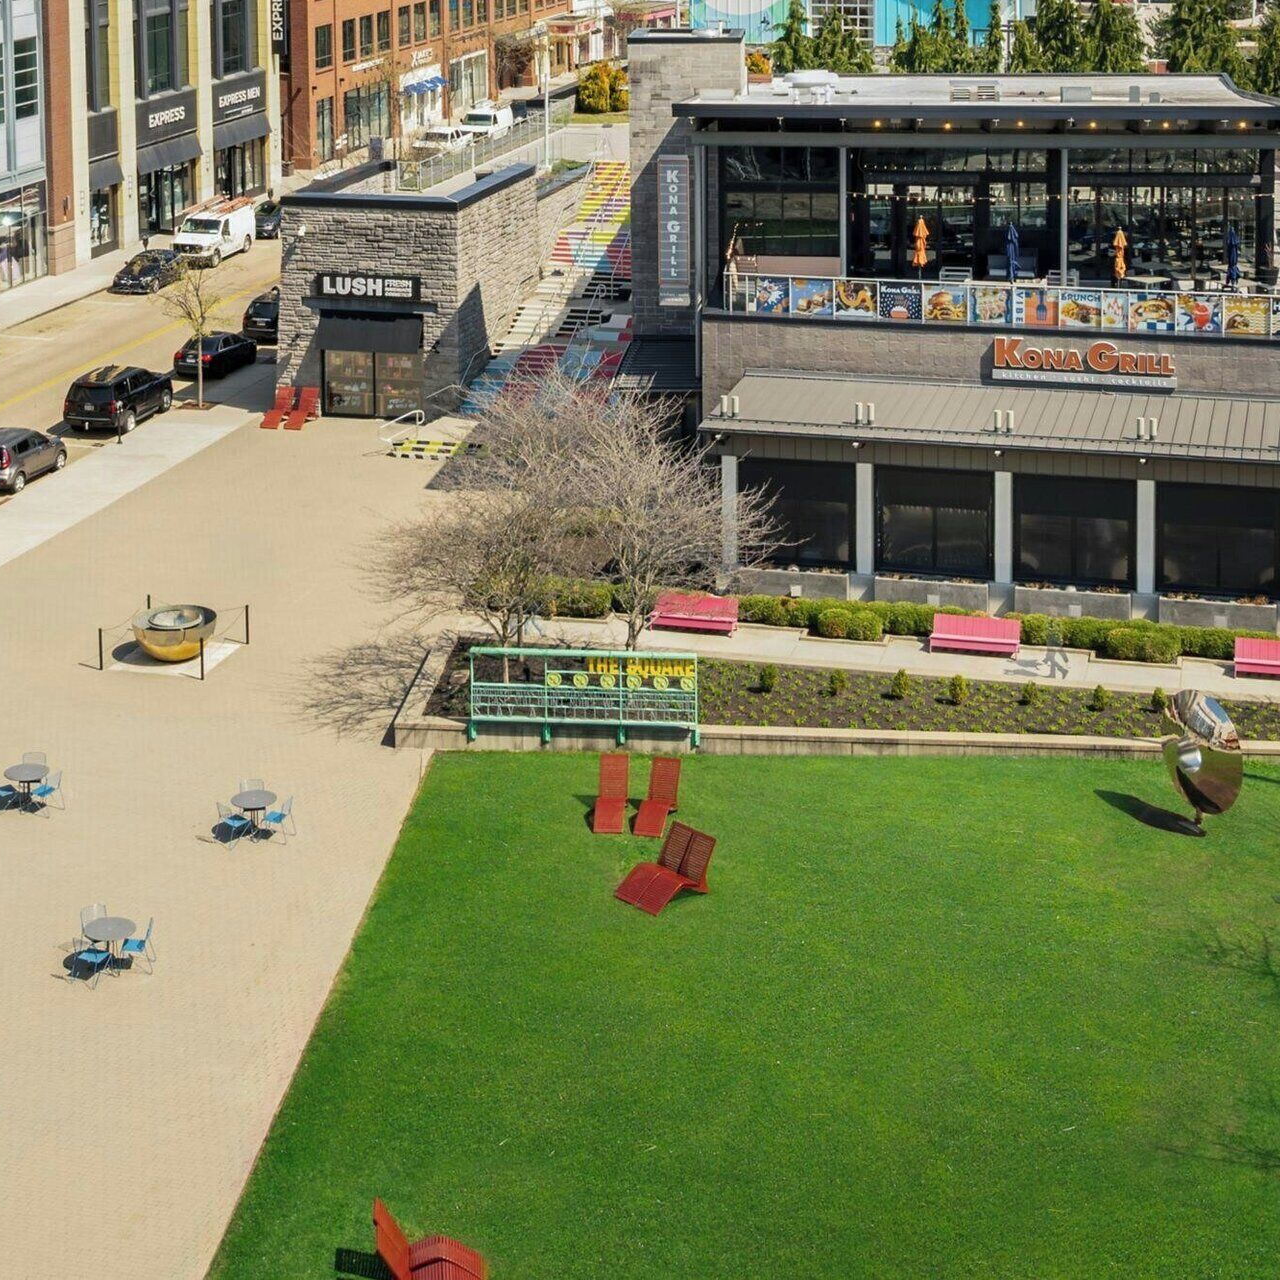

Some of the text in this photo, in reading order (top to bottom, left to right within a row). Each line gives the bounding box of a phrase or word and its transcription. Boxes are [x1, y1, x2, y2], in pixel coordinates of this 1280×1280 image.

[219, 86, 261, 108] EXPRESS MEN
[148, 106, 186, 128] EXPRESS
[666, 170, 679, 215] KONA
[666, 220, 680, 277] GRILL
[323, 276, 383, 297] LUSH
[384, 279, 412, 288] FRESH
[880, 285, 901, 294] KONA
[994, 336, 1176, 375] KONA GRILL
[1001, 371, 1168, 387] kitchen sushi cocktails
[587, 656, 696, 678] THE SQUARE
